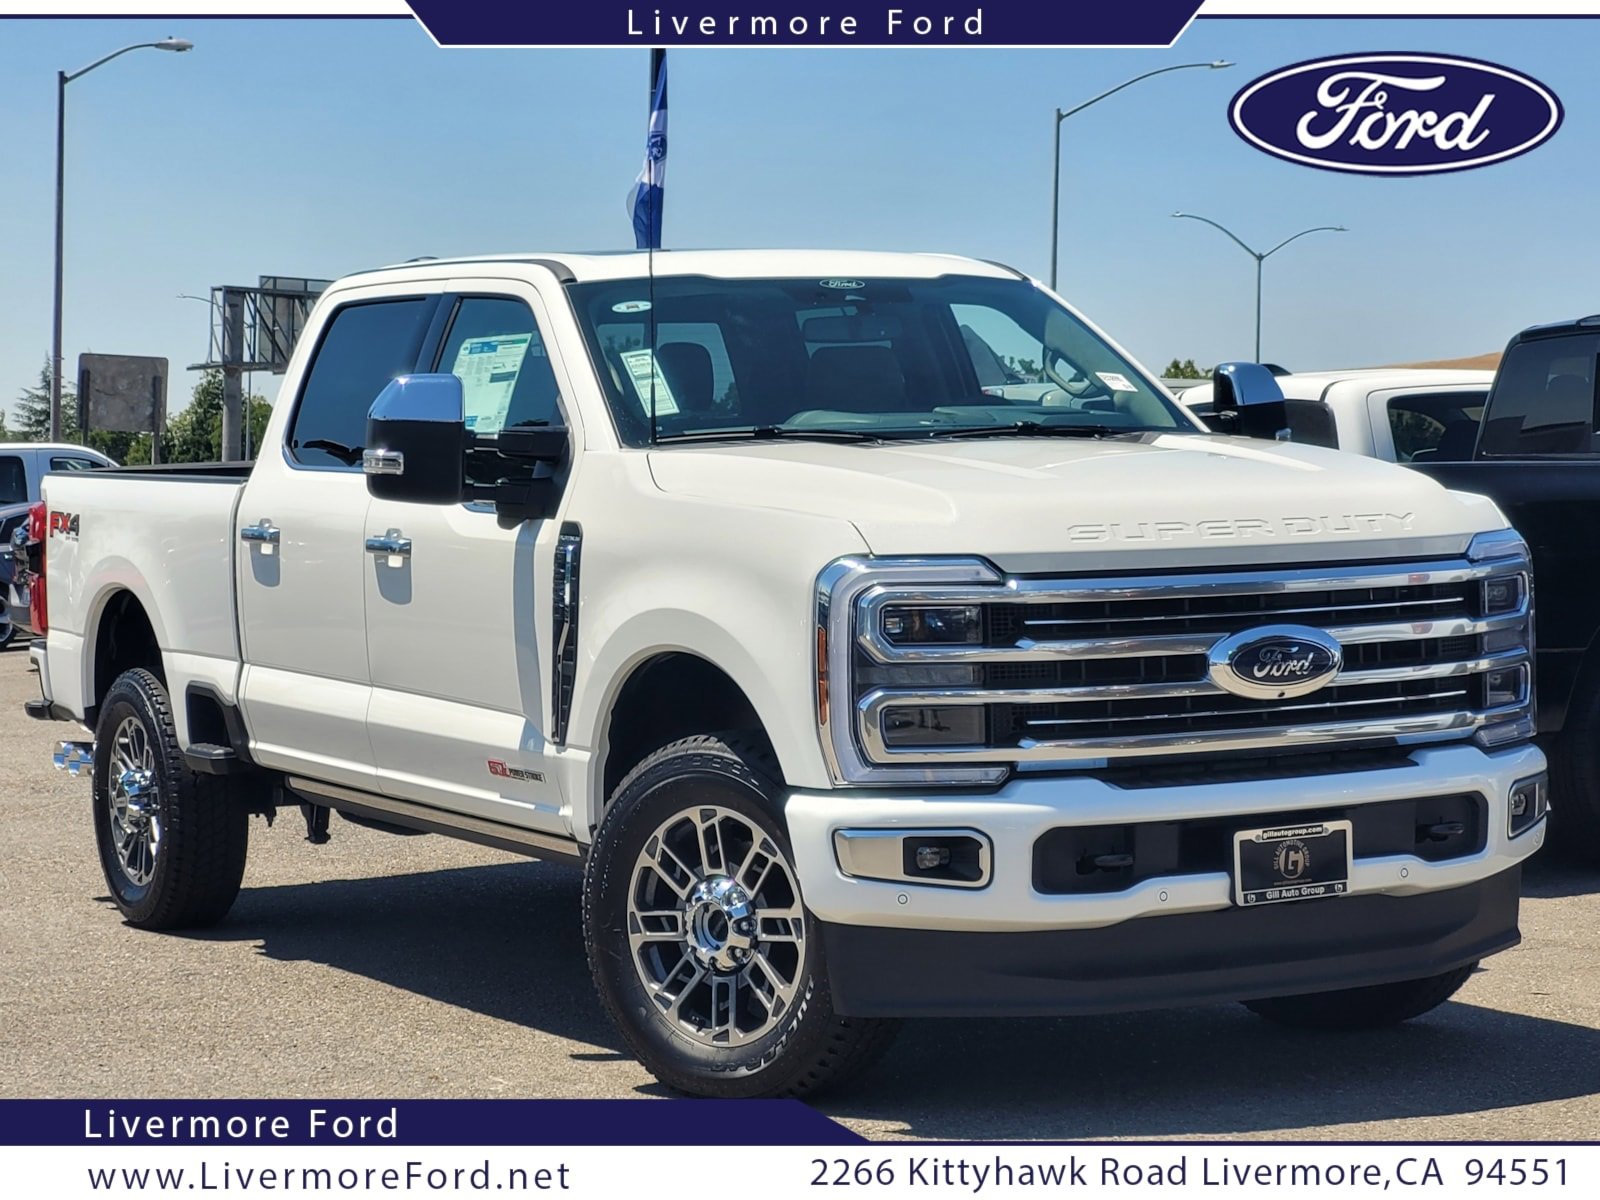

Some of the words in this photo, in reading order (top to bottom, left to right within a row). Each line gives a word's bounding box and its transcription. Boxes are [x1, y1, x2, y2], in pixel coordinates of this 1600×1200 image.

[49, 510, 80, 538] FX4
[1066, 519, 1276, 543] SUPER
[1281, 512, 1416, 537] DUTY
[1253, 646, 1314, 678] Ford
[1263, 827, 1322, 839] gillautogroup.com
[1266, 890, 1280, 900] Gill
[1281, 889, 1300, 898] Auto
[1300, 886, 1325, 896] Group
